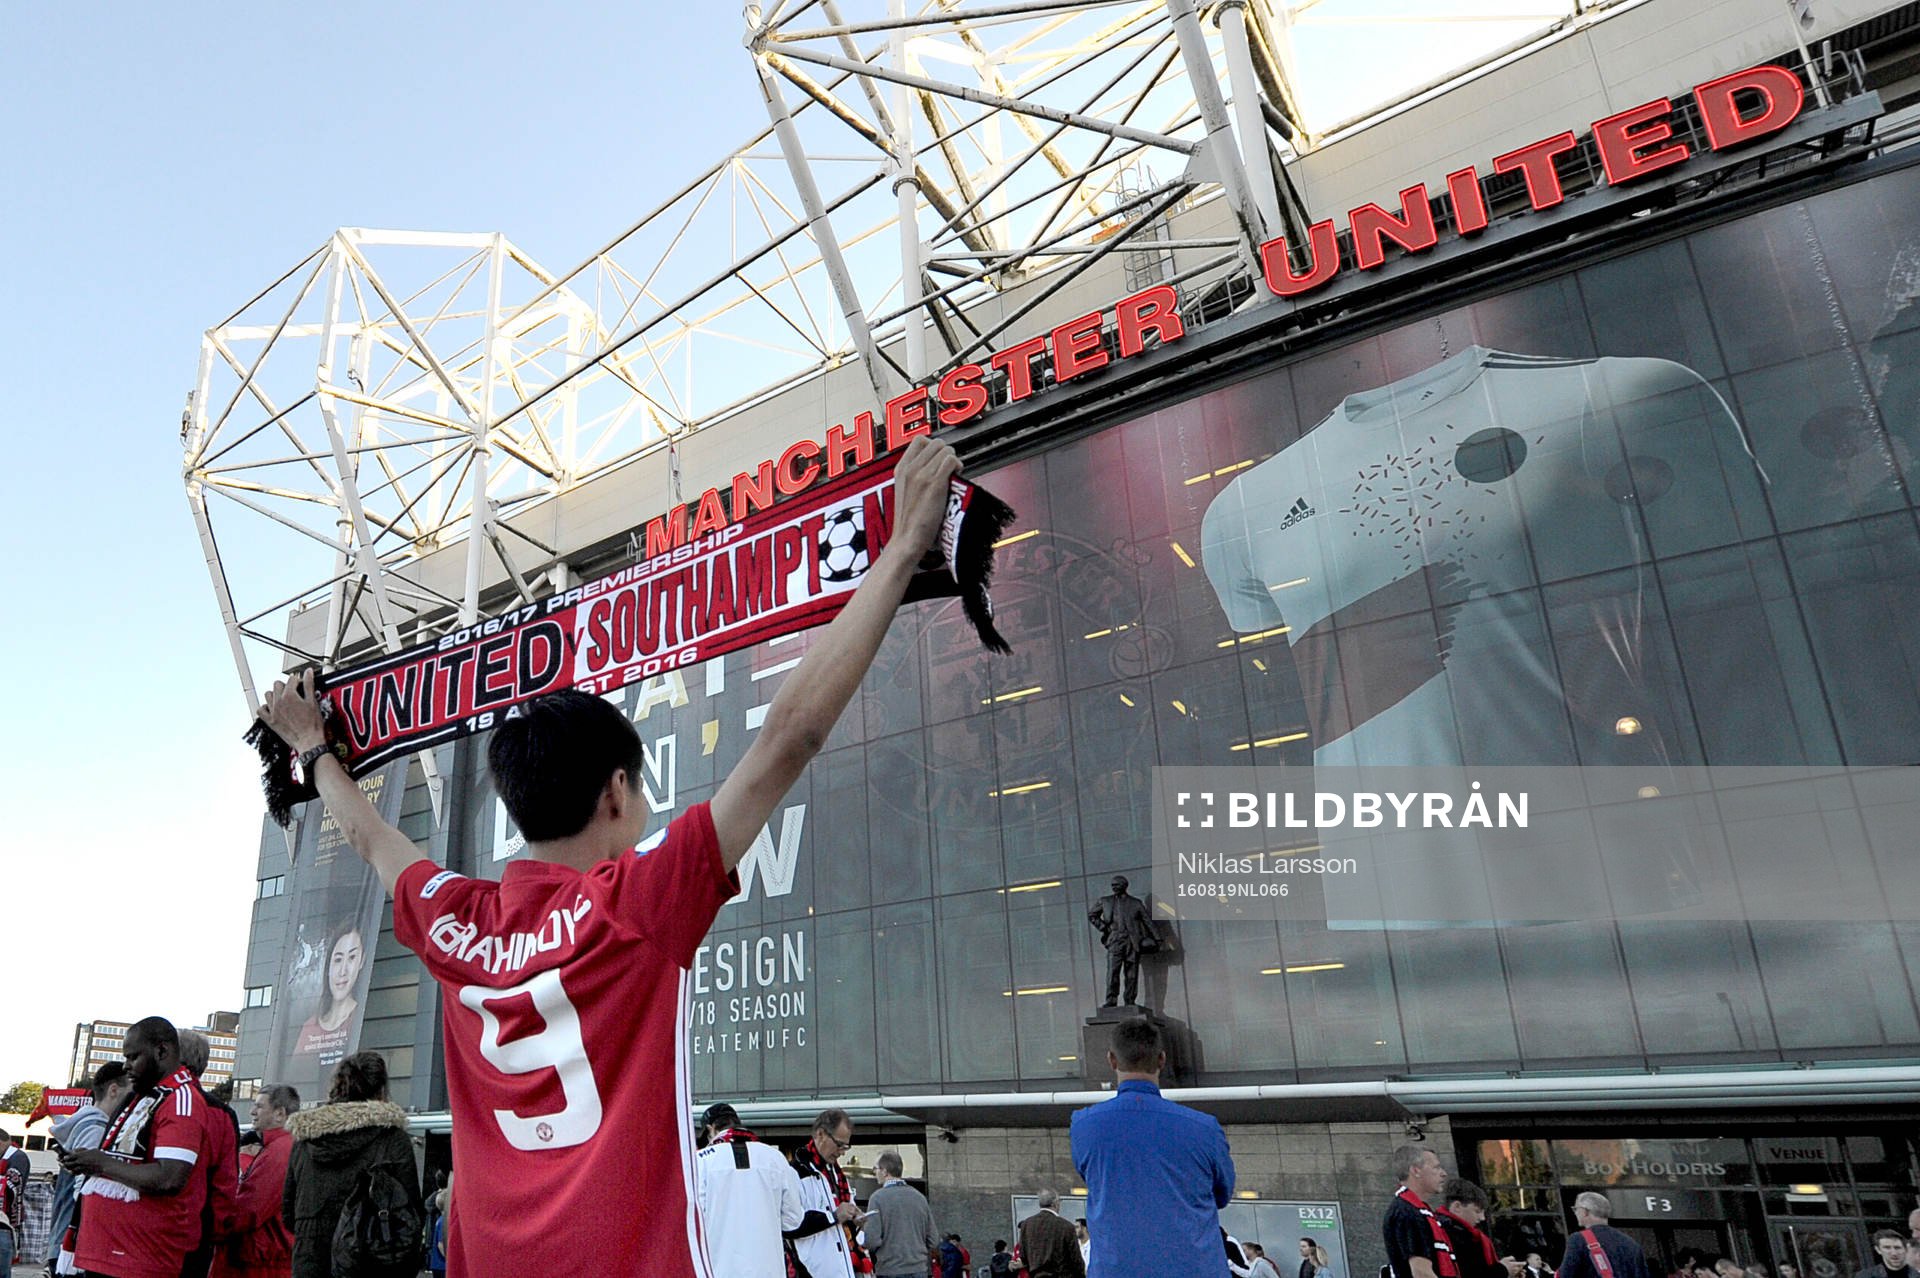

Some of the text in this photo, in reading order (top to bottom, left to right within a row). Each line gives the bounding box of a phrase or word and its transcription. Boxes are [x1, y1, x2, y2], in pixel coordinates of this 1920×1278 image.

[646, 65, 1803, 559] MANCHESTER UNITED
[1280, 507, 1316, 531] adidas
[437, 523, 744, 652] 2016/17 PREMIERSHIP
[341, 620, 564, 750] UNITED
[465, 711, 494, 733] 19
[623, 647, 698, 683] 2016
[358, 774, 385, 792] YOUR
[694, 931, 805, 994] ESIGN
[730, 991, 805, 1022] SEASON
[459, 968, 603, 1151] 9
[694, 1027, 806, 1054] EATEMUFC
[48, 1095, 94, 1107] MANCHESTER
[1298, 1207, 1334, 1219] EX12
